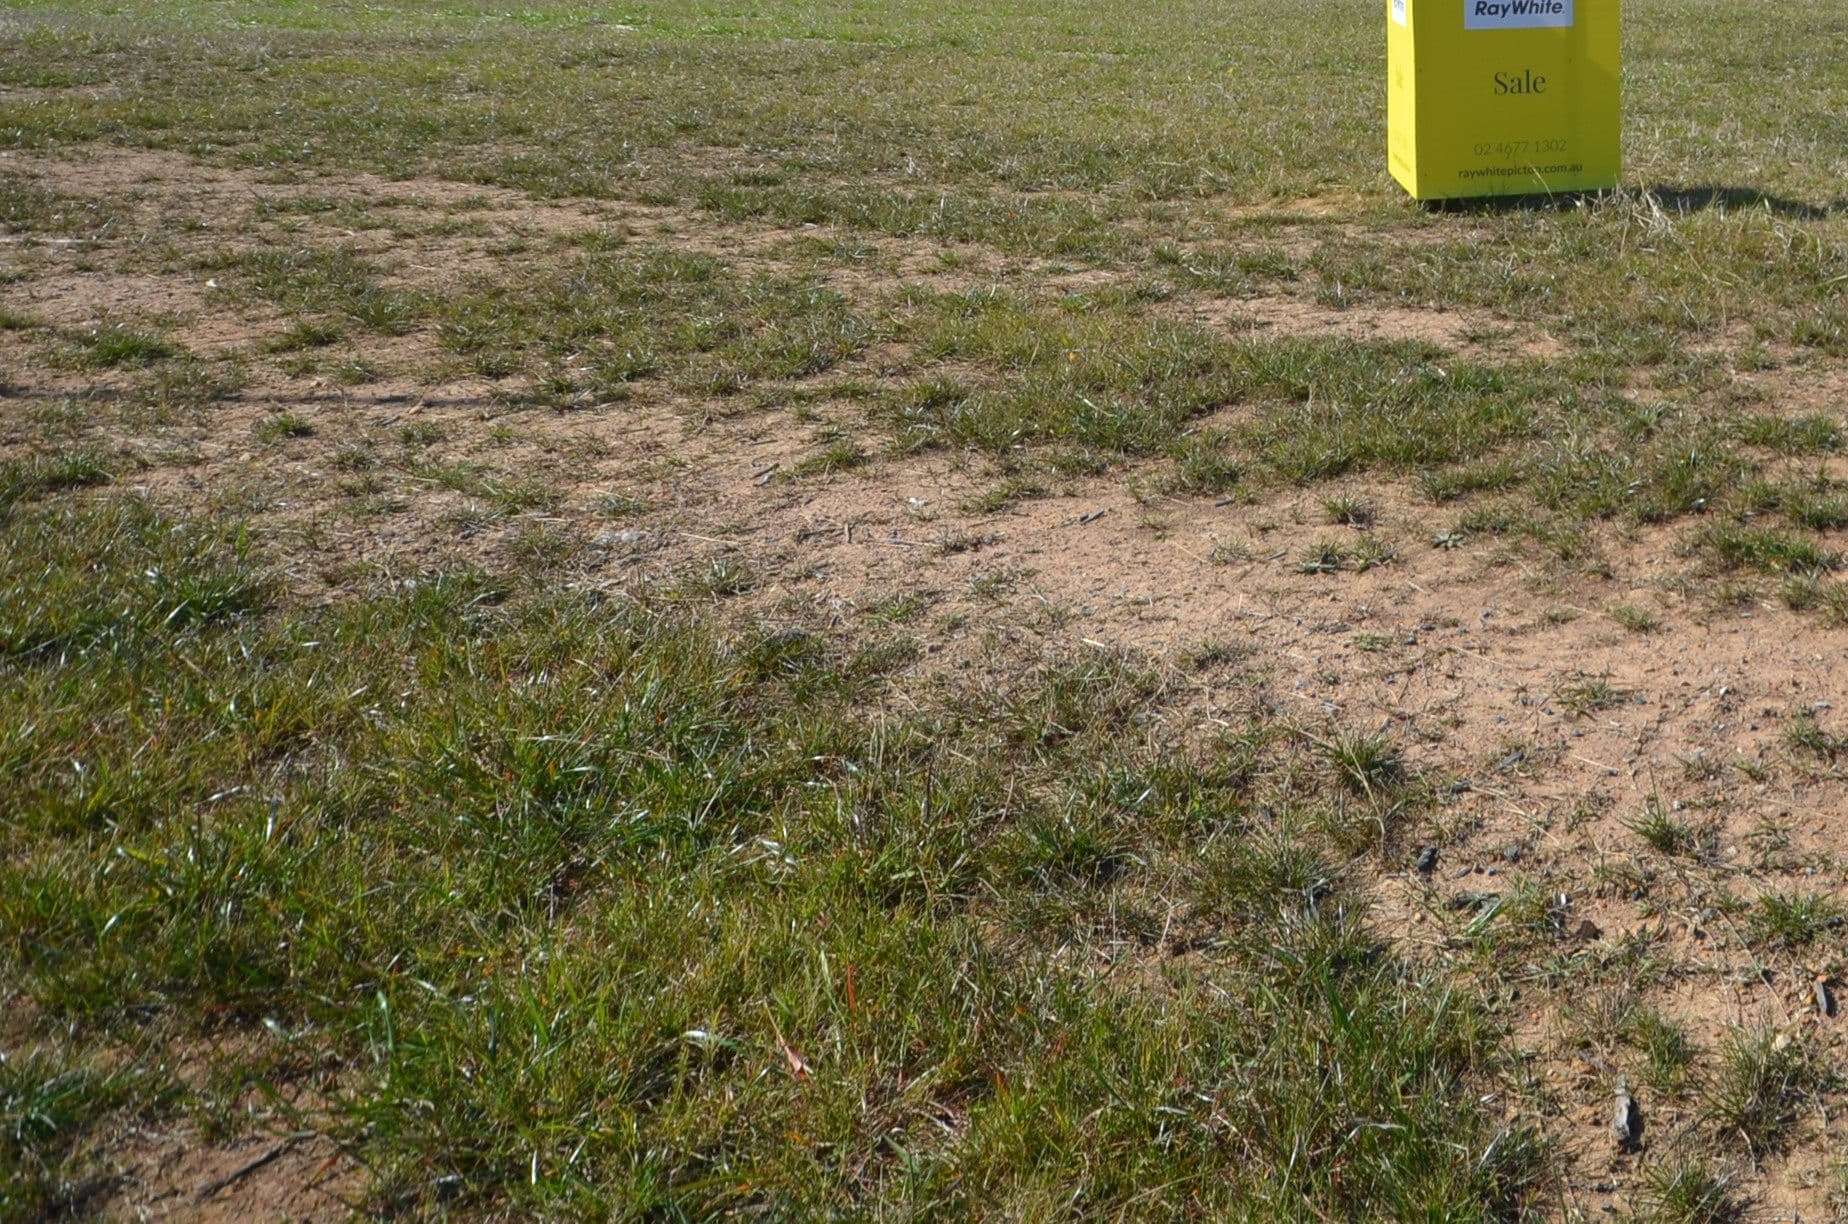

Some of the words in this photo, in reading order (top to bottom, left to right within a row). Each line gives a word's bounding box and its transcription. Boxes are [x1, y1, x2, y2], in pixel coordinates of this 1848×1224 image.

[1475, 0, 1563, 18] RayWhite
[1494, 69, 1546, 95] Sale
[1473, 142, 1491, 156] 02
[1535, 138, 1567, 153] 1302
[1458, 161, 1583, 179] raywhitepicton.com.au
